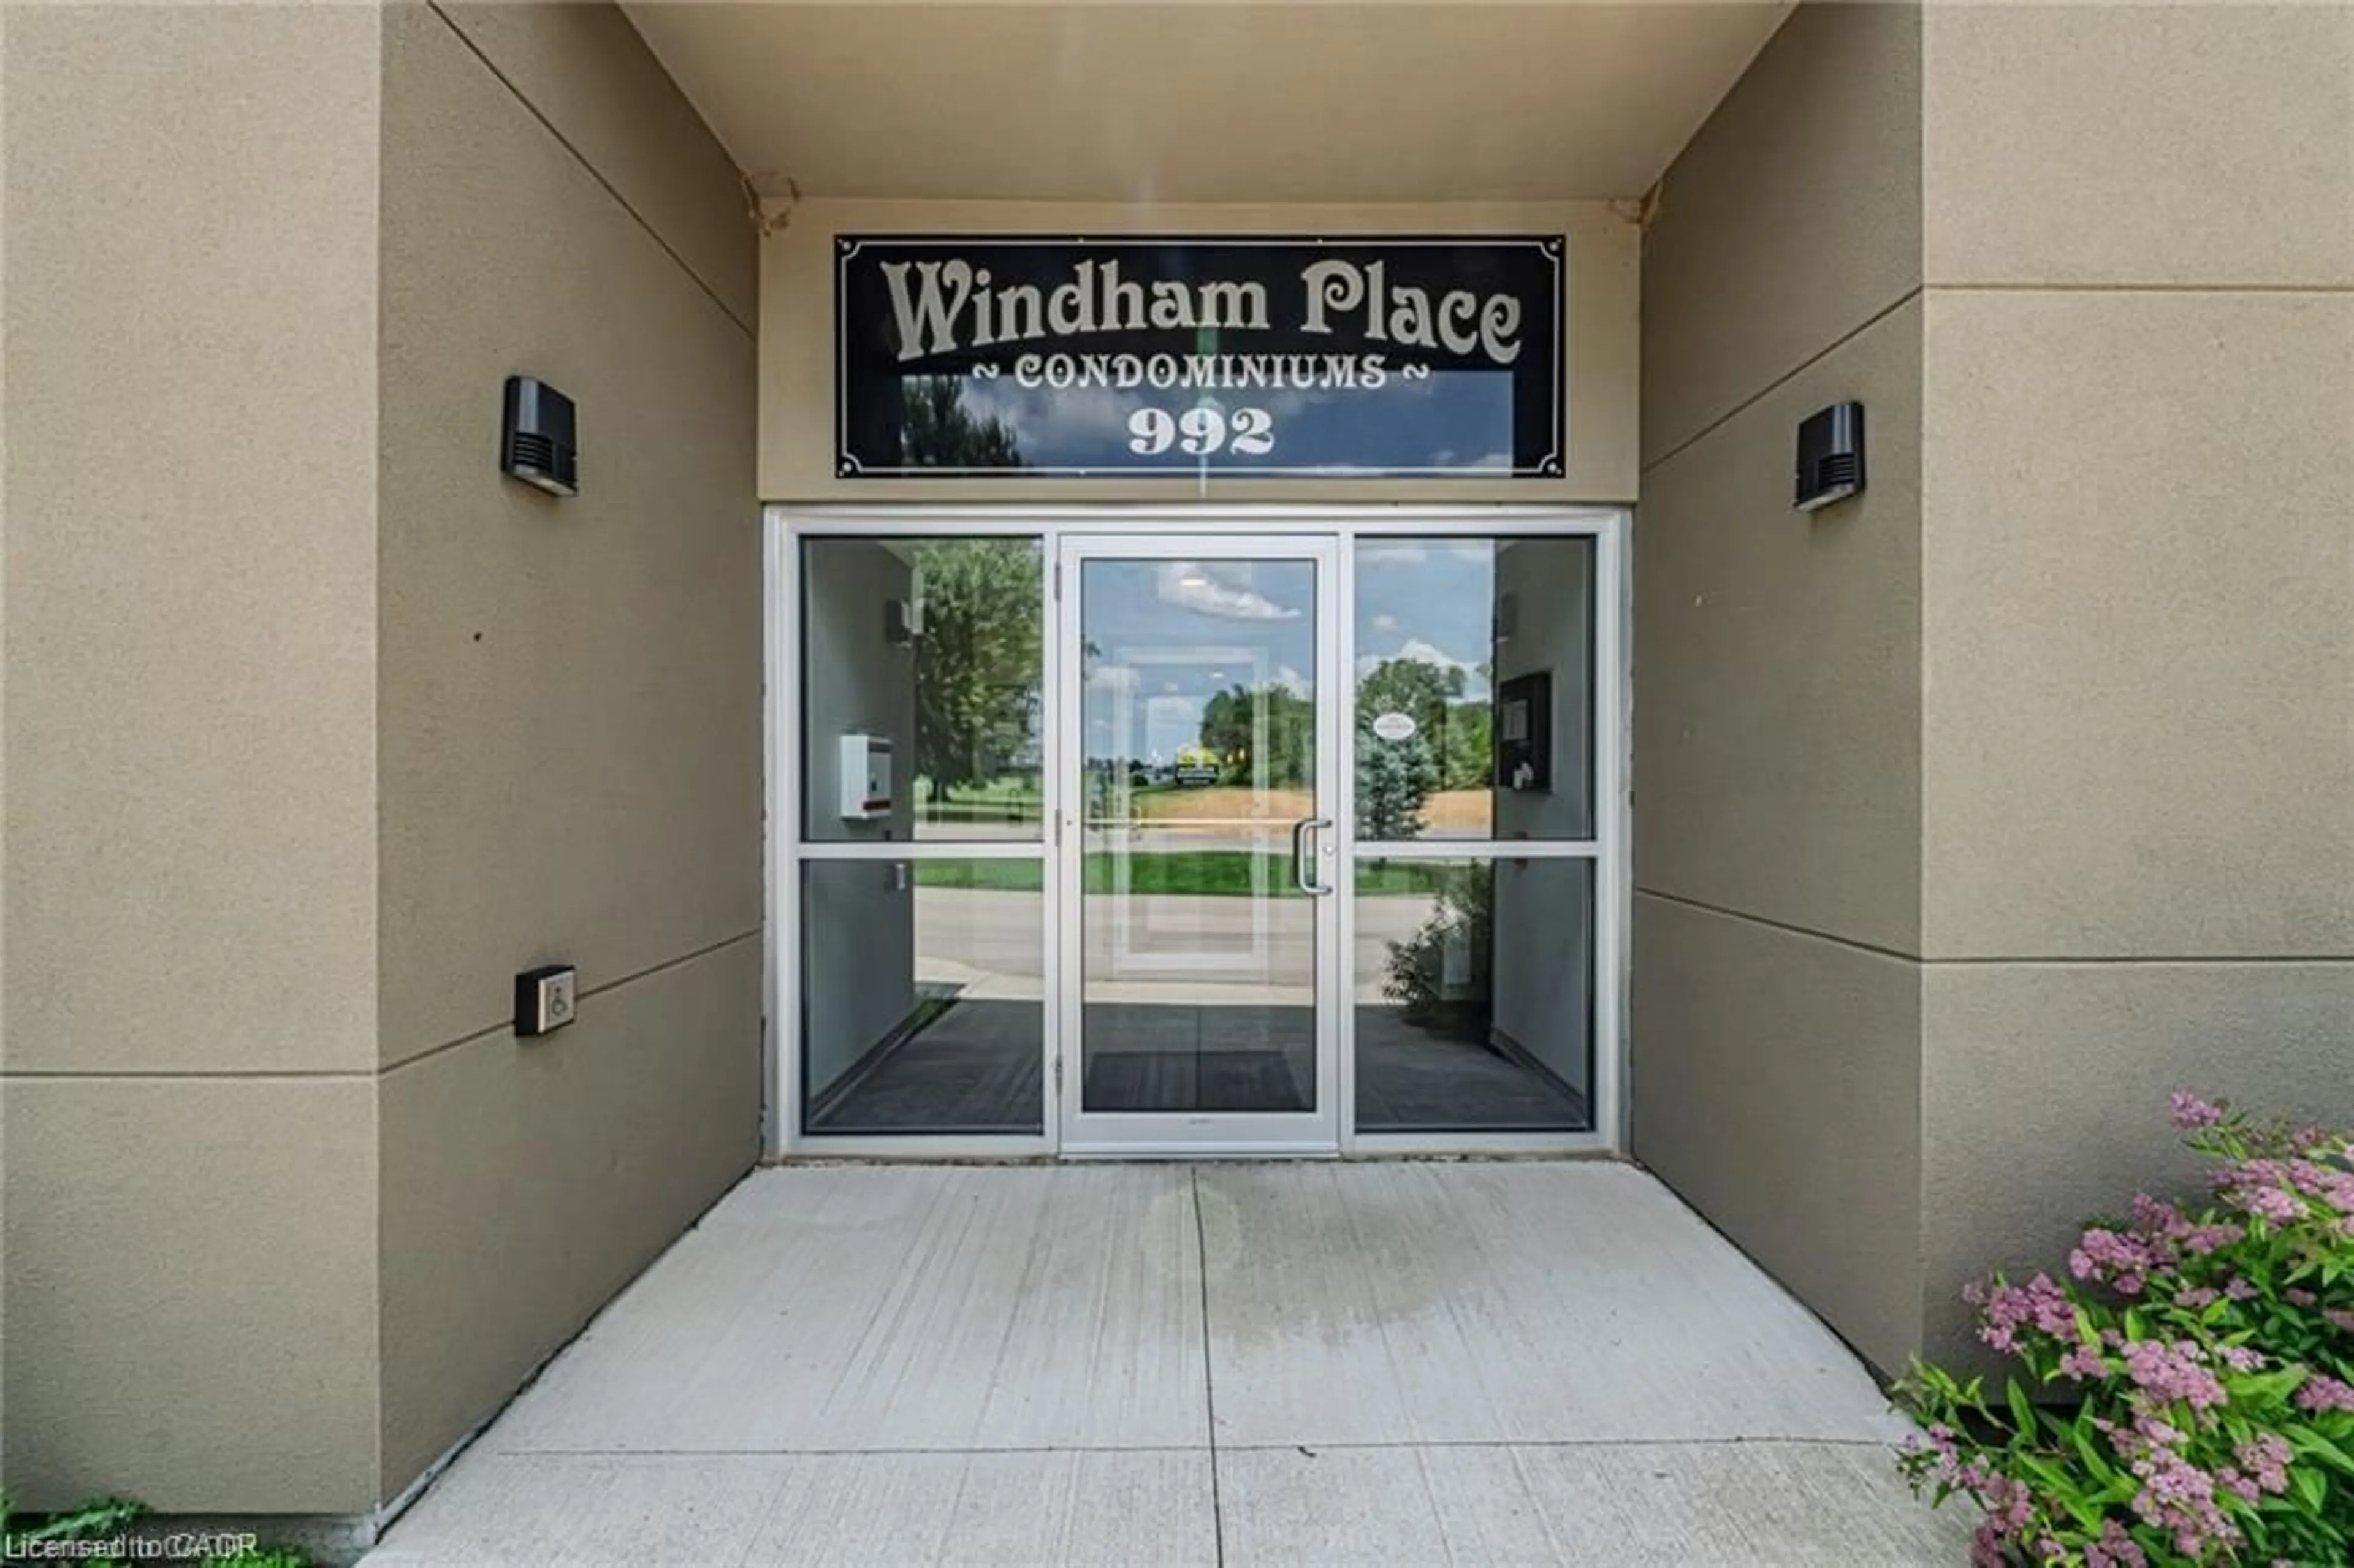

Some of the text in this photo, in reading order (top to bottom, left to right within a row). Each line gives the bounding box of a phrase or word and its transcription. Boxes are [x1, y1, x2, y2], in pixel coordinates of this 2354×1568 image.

[880, 259, 1522, 364] Windham Place
[1015, 353, 1387, 390] CONDOMINIUMS
[1128, 407, 1274, 454] 992
